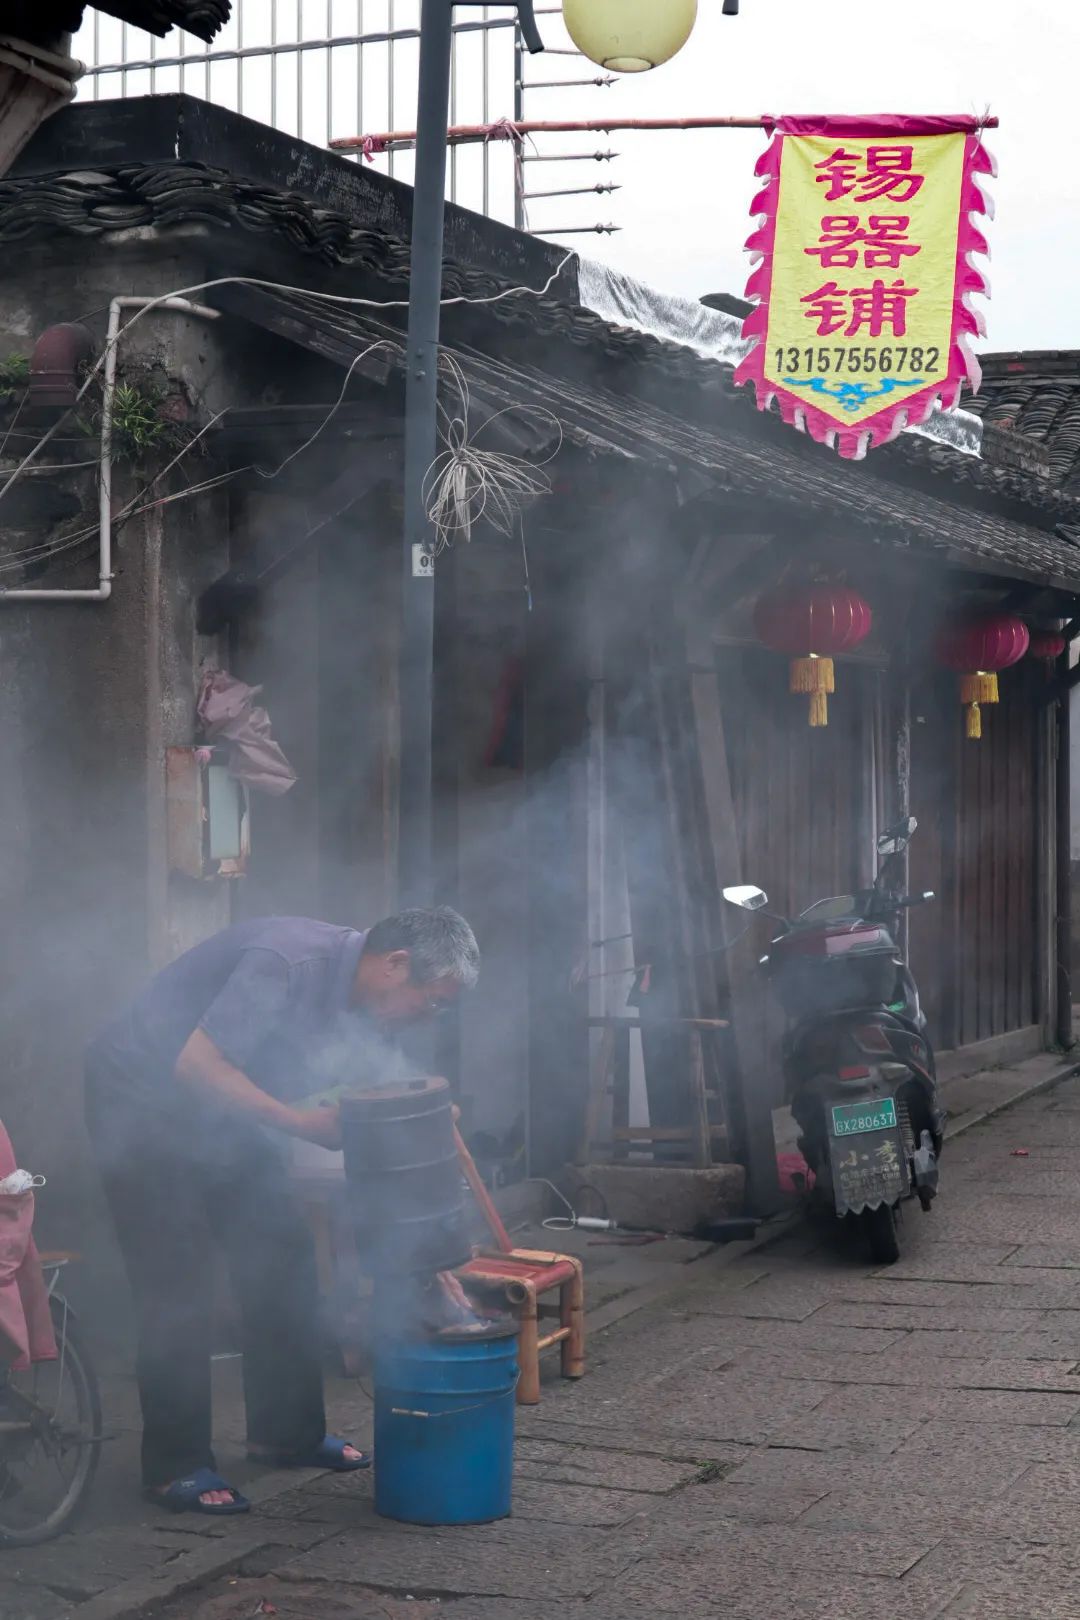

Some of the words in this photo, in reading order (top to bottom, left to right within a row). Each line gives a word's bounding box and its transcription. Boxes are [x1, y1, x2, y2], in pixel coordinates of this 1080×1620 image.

[800, 145, 925, 337] 锡器铺
[775, 347, 940, 373] 13157556782
